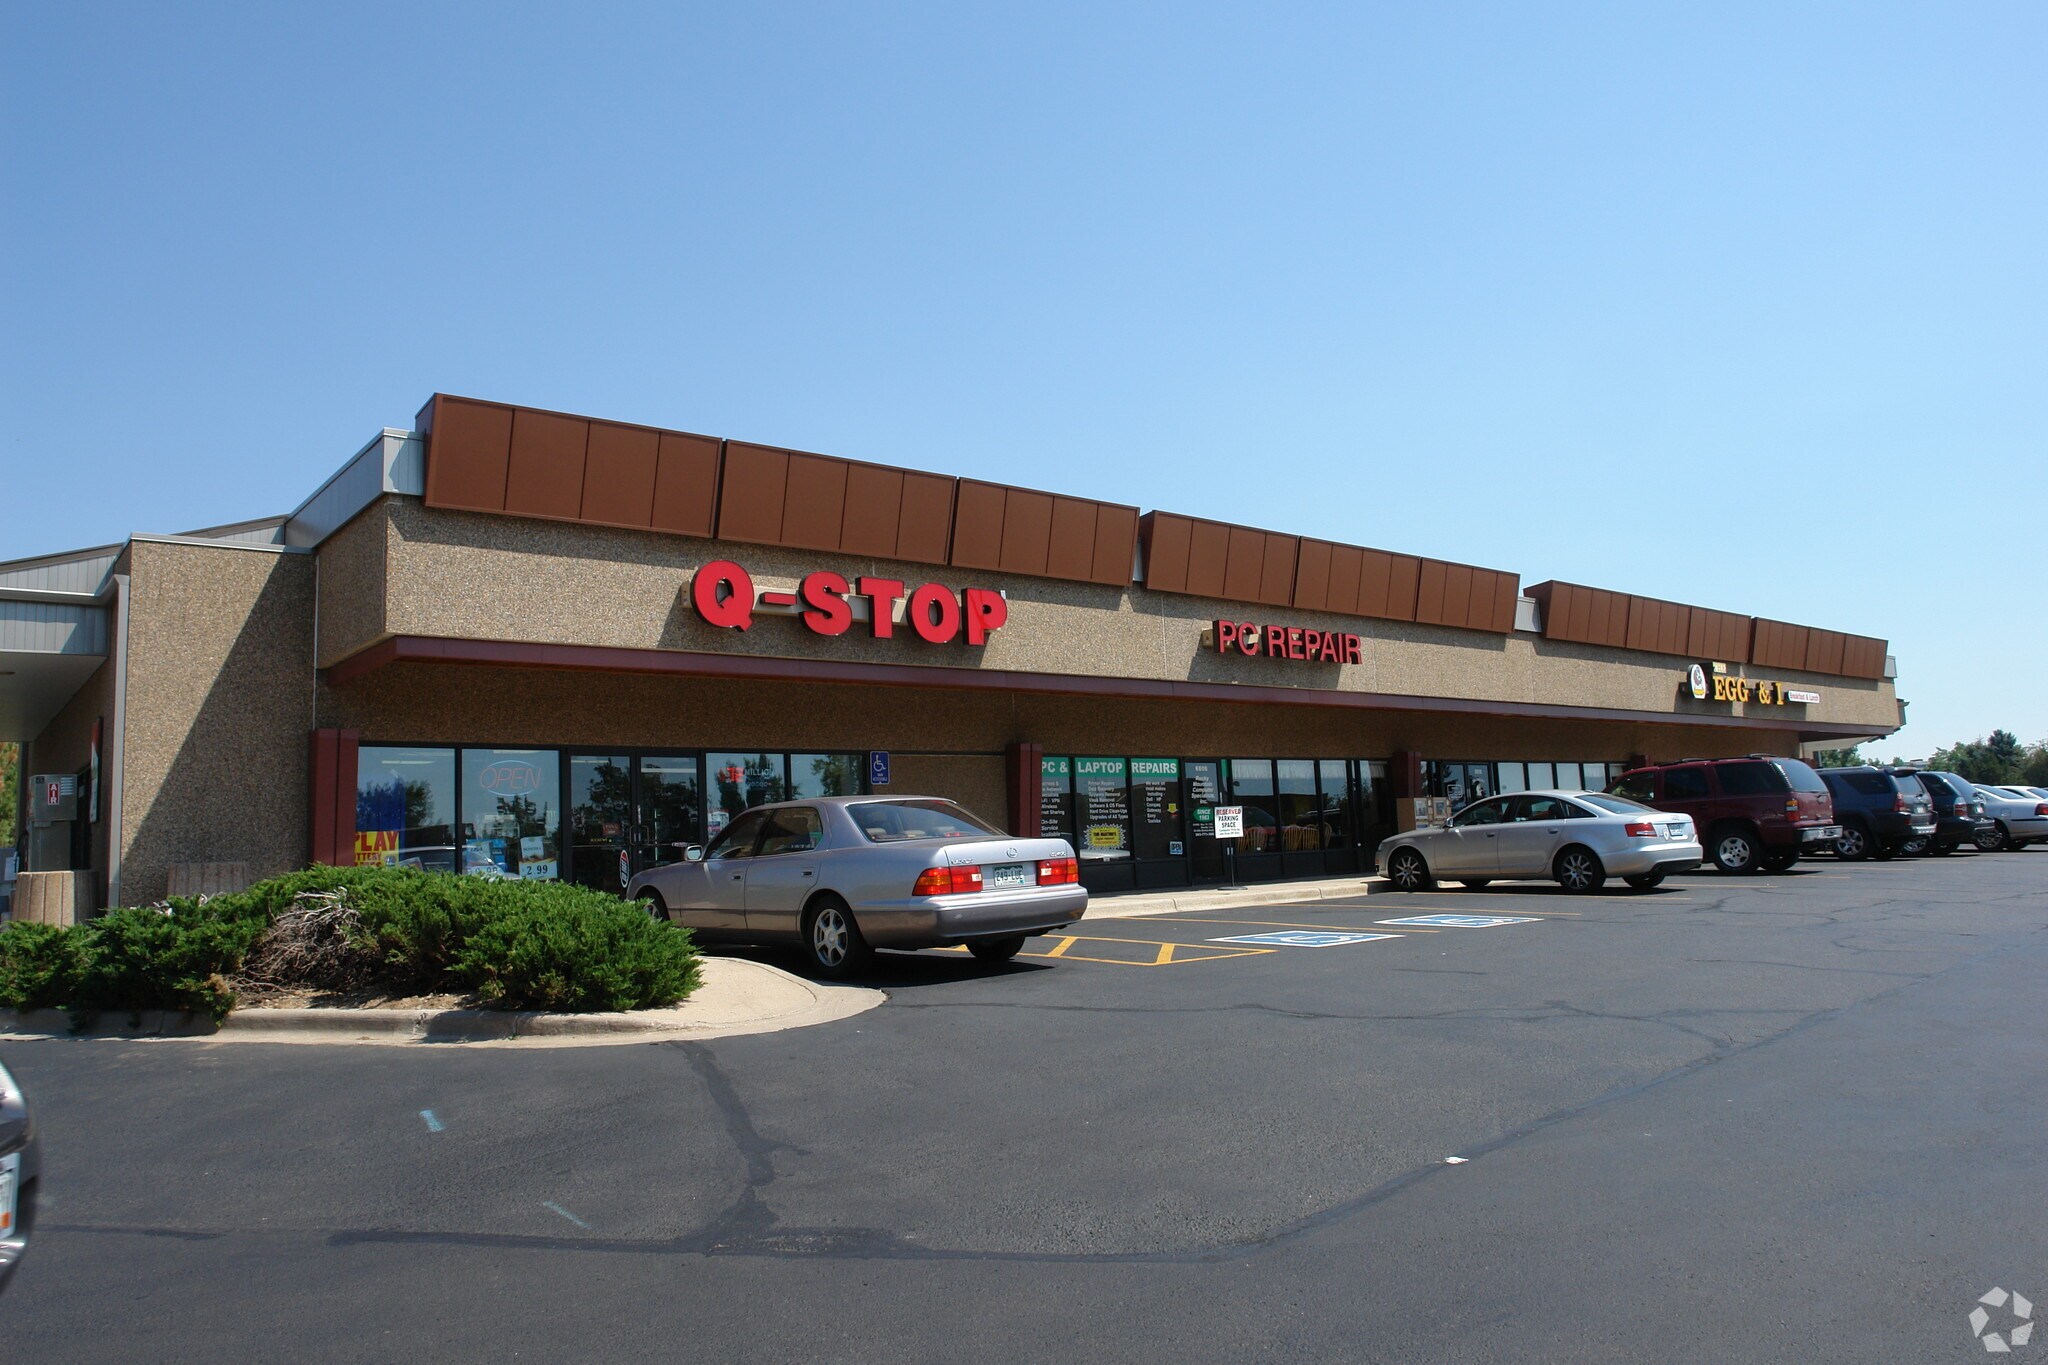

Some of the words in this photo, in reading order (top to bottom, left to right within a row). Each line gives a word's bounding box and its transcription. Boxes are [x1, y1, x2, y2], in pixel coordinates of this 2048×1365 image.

[692, 560, 1007, 645] Q-STOP
[1214, 620, 1259, 656] PC
[1263, 625, 1362, 664] REPAIR
[1712, 675, 1748, 702] EGG
[1758, 680, 1770, 704] &
[1042, 762, 1056, 773] PC
[1060, 762, 1068, 773] &
[1078, 762, 1122, 773] LAPTOP
[1132, 763, 1177, 774] REPAIRS
[480, 768, 542, 790] OPEN
[354, 852, 381, 861] TTERY
